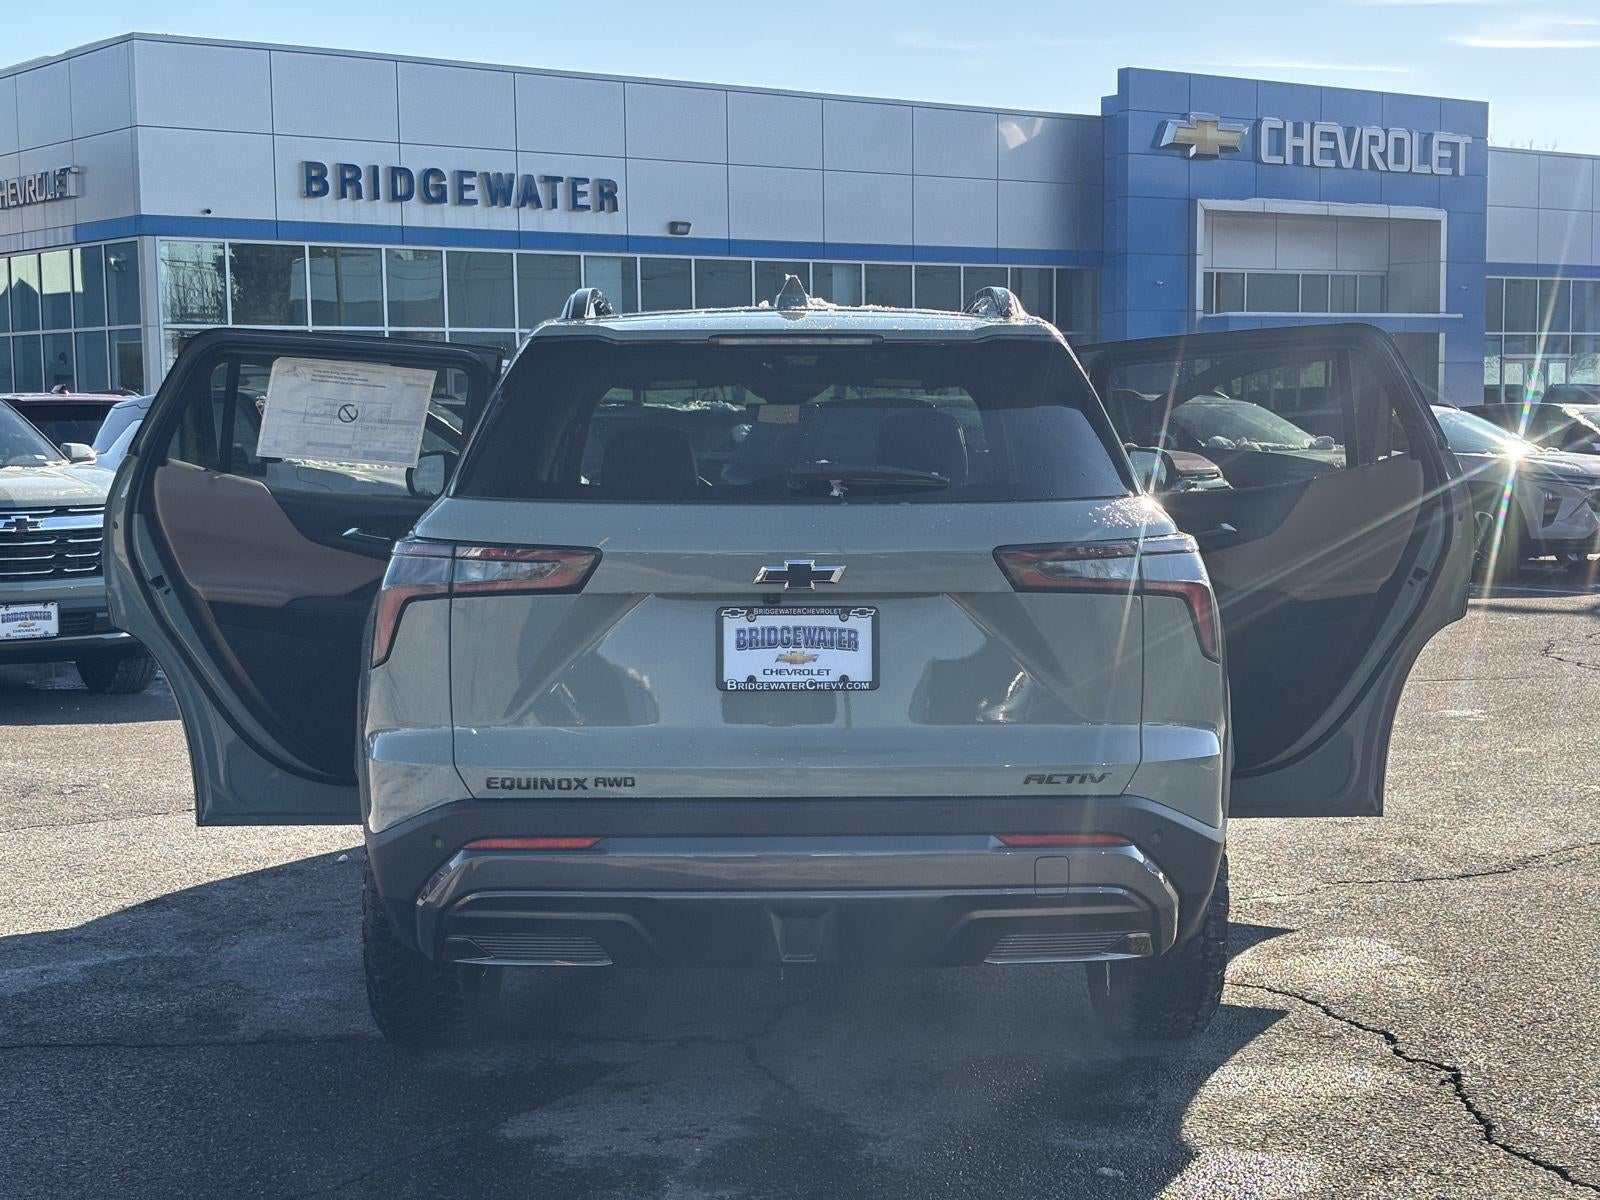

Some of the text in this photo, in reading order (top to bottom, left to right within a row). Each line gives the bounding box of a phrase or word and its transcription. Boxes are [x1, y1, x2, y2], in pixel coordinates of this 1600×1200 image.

[1260, 117, 1472, 176] CHEVROLET
[0, 166, 79, 208] HEVROLET
[300, 160, 618, 212] BRIDGEWATER
[735, 626, 859, 651] BRIDGEWATER
[763, 668, 831, 676] CHEVROLET
[486, 776, 636, 790] EQUINOX AWD
[1023, 773, 1112, 785] ACTIV
